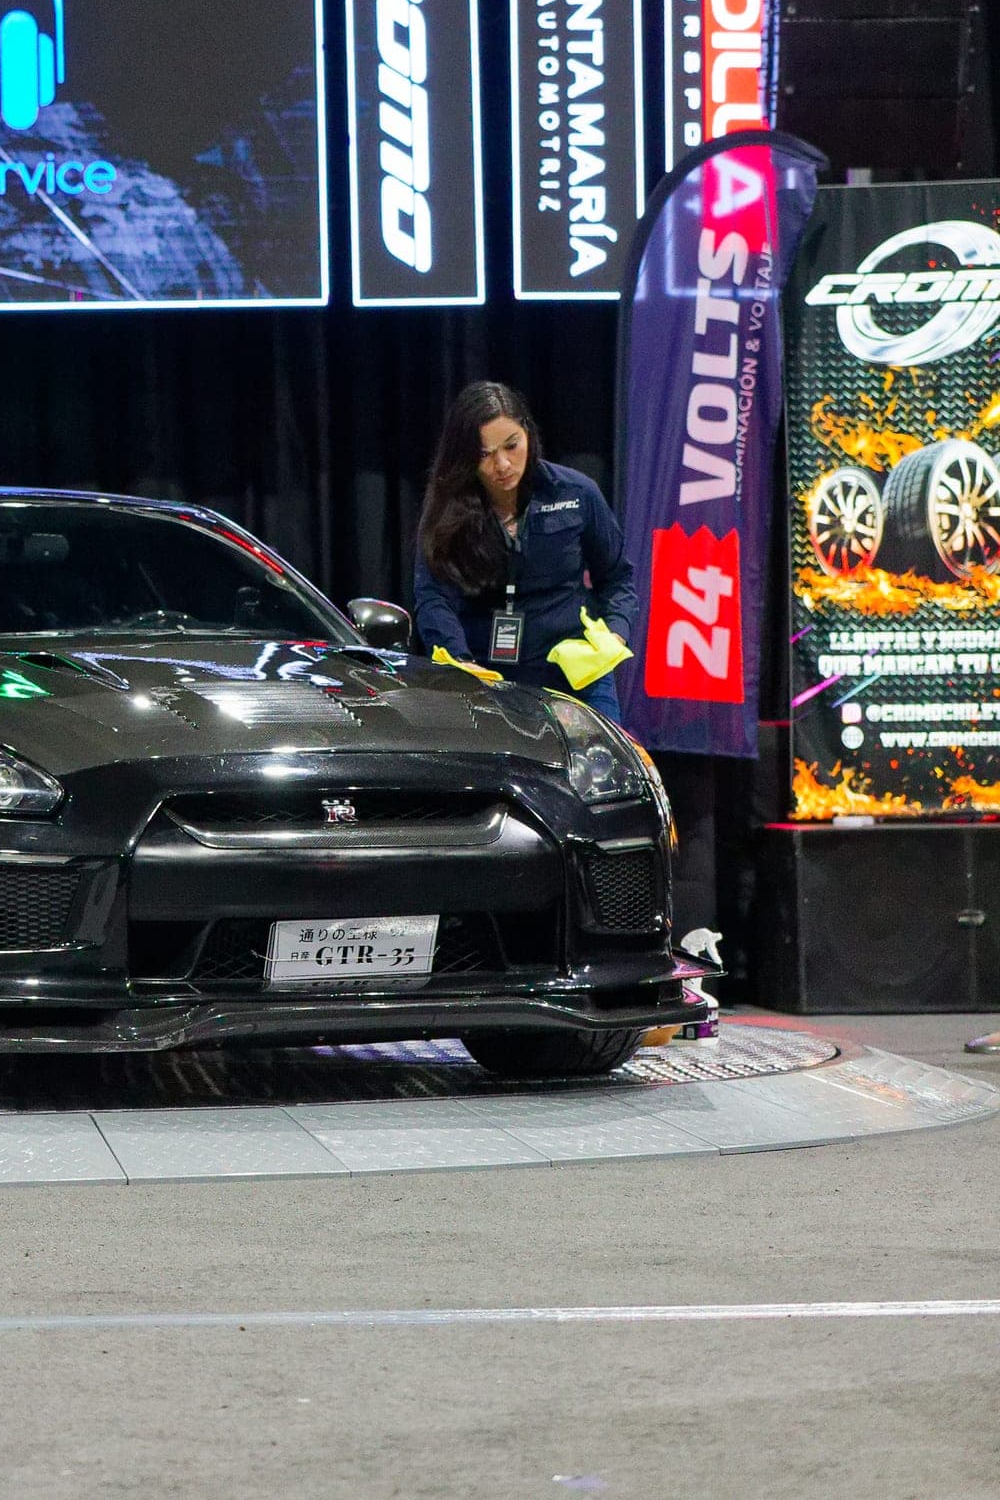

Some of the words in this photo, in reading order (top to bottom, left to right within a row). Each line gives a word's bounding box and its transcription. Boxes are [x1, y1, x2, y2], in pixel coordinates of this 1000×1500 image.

[679, 228, 749, 506] VOLTS
[666, 565, 734, 680] 24
[818, 654, 861, 678] QUE
[315, 945, 415, 967] GTR-35
